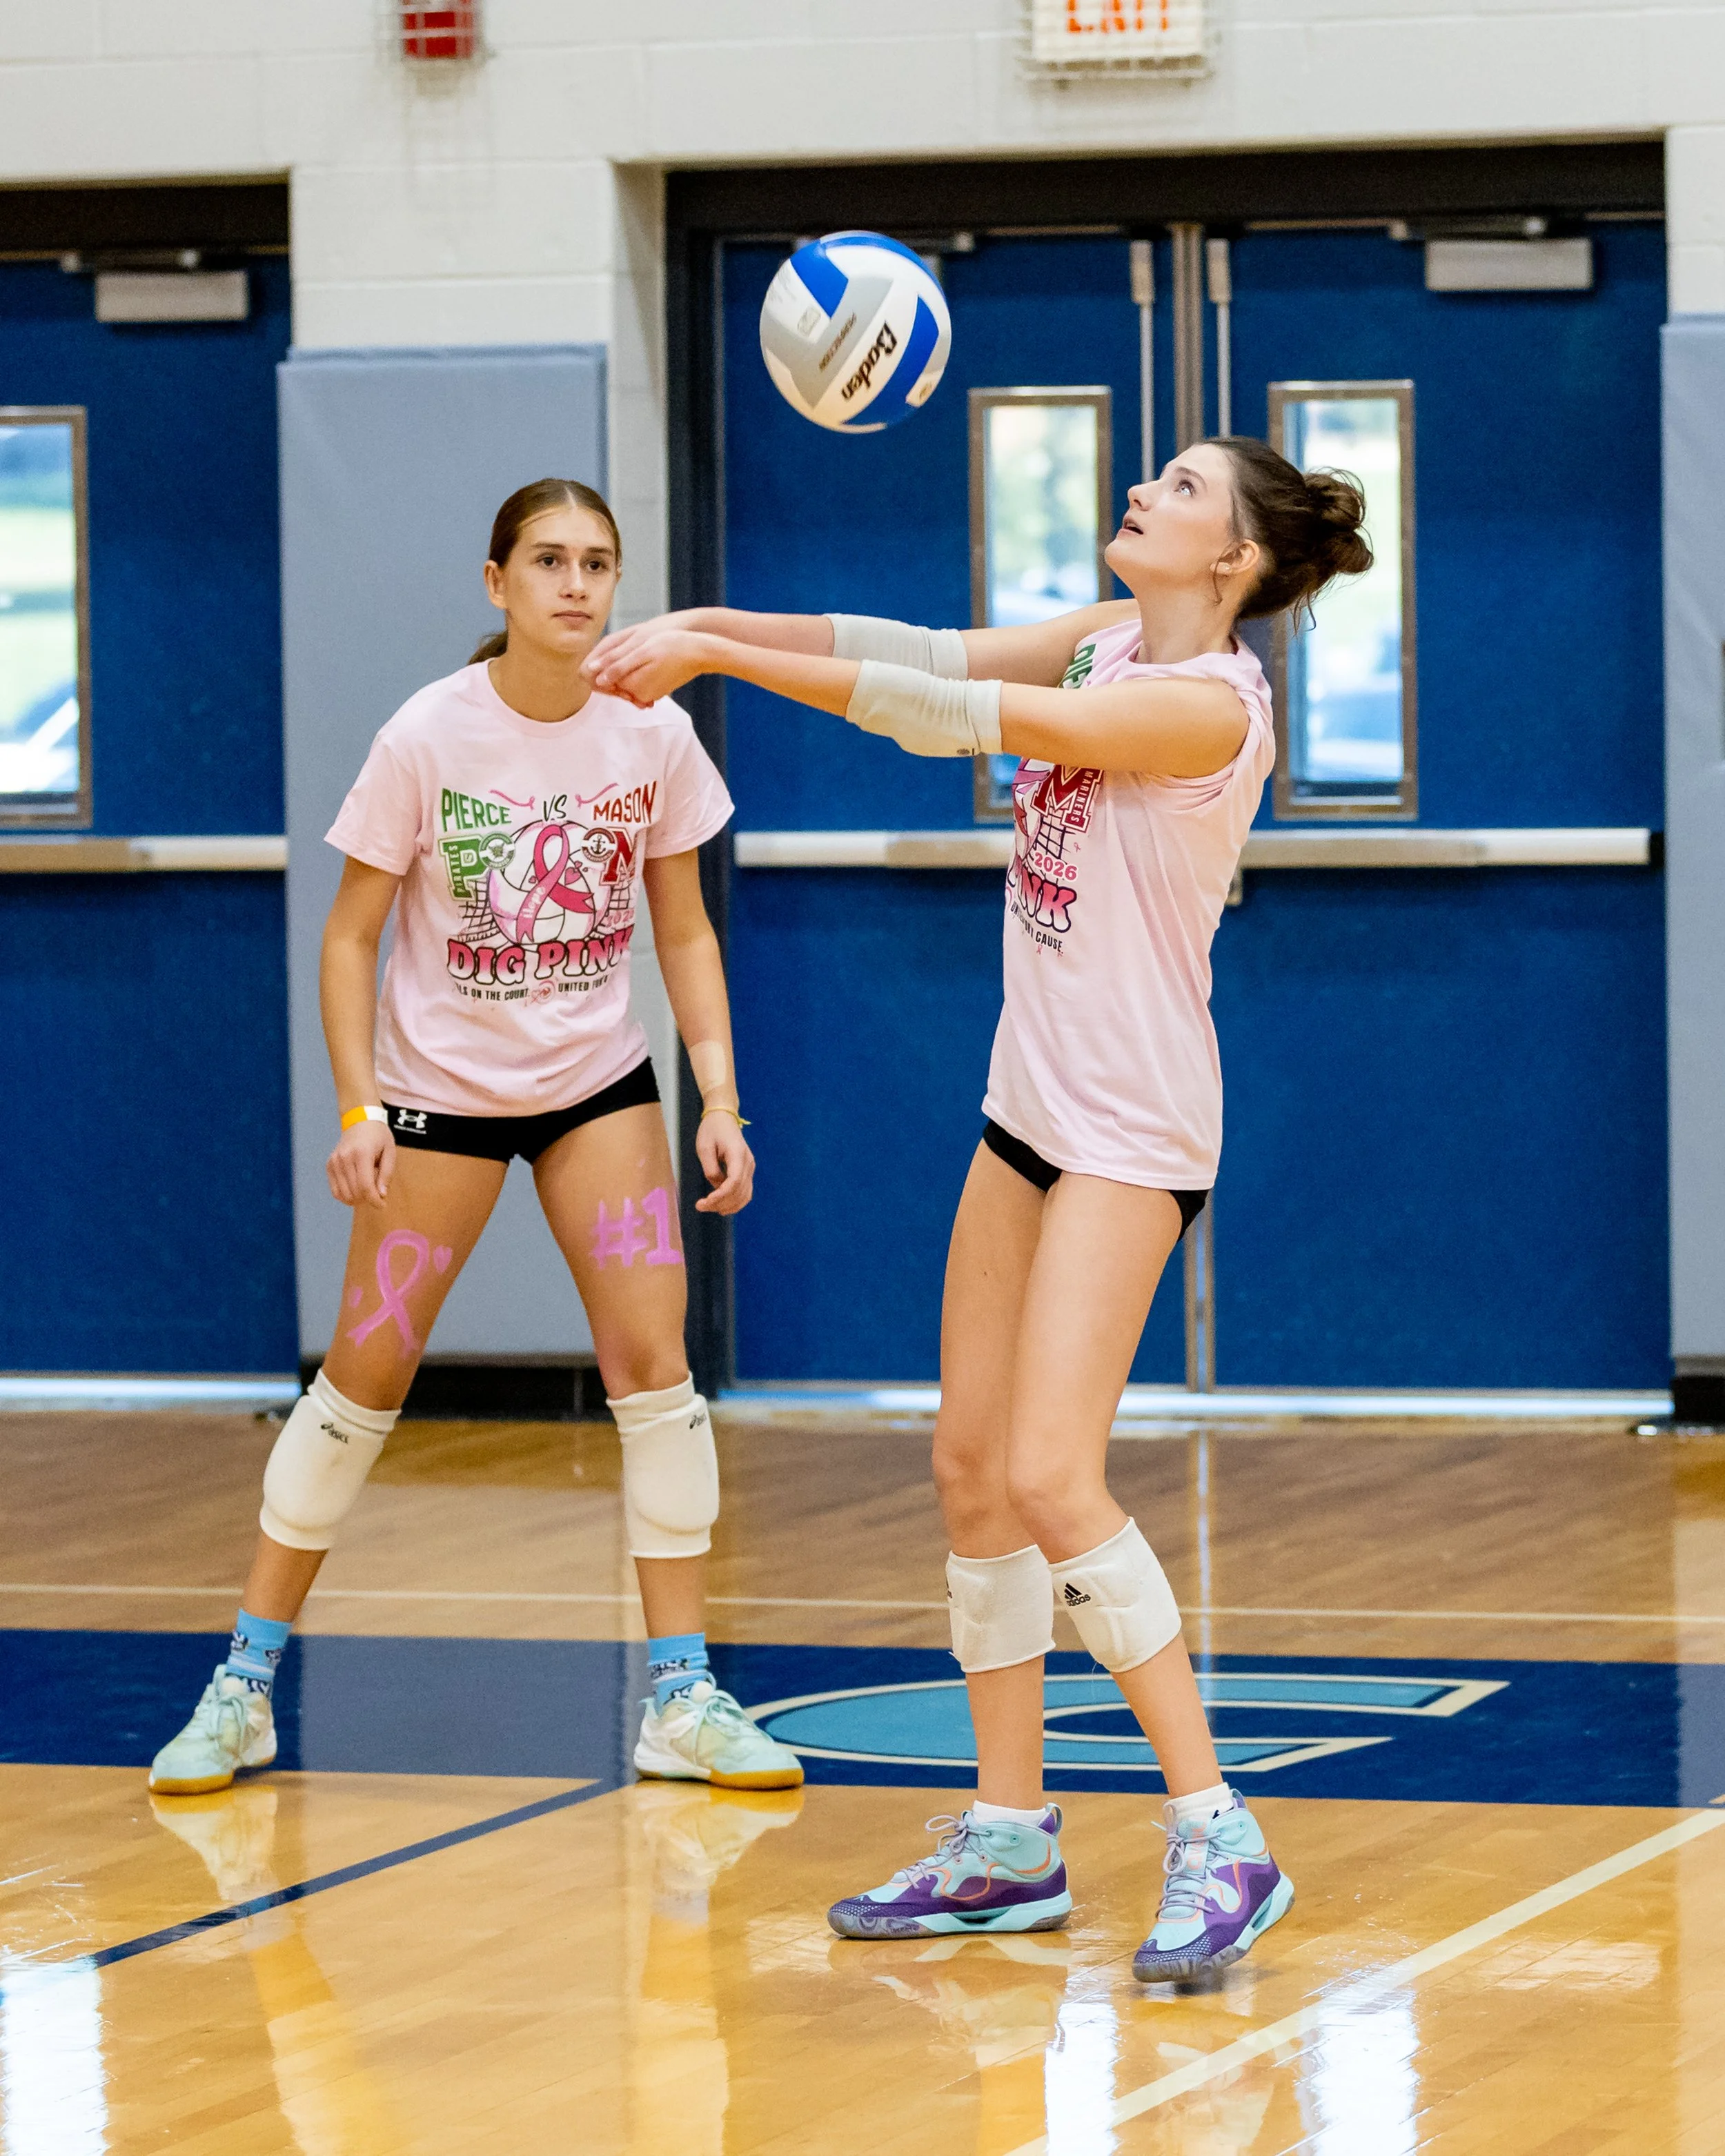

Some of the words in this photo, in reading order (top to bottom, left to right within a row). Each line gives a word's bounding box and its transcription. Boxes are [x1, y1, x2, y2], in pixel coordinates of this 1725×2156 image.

[840, 321, 897, 399] Baden
[1058, 642, 1096, 689] PIE
[441, 787, 513, 832] PIERCE
[543, 794, 567, 822] VS
[593, 780, 657, 824] MASON
[1070, 771, 1094, 822] MARINERS
[1034, 852, 1078, 881] 2026
[447, 938, 526, 986] DIG
[1035, 931, 1064, 954] CAUSE.
[471, 987, 482, 1000] ON
[485, 989, 501, 1001] THE
[558, 981, 590, 992] UNITED
[588, 1186, 684, 1270] #1
